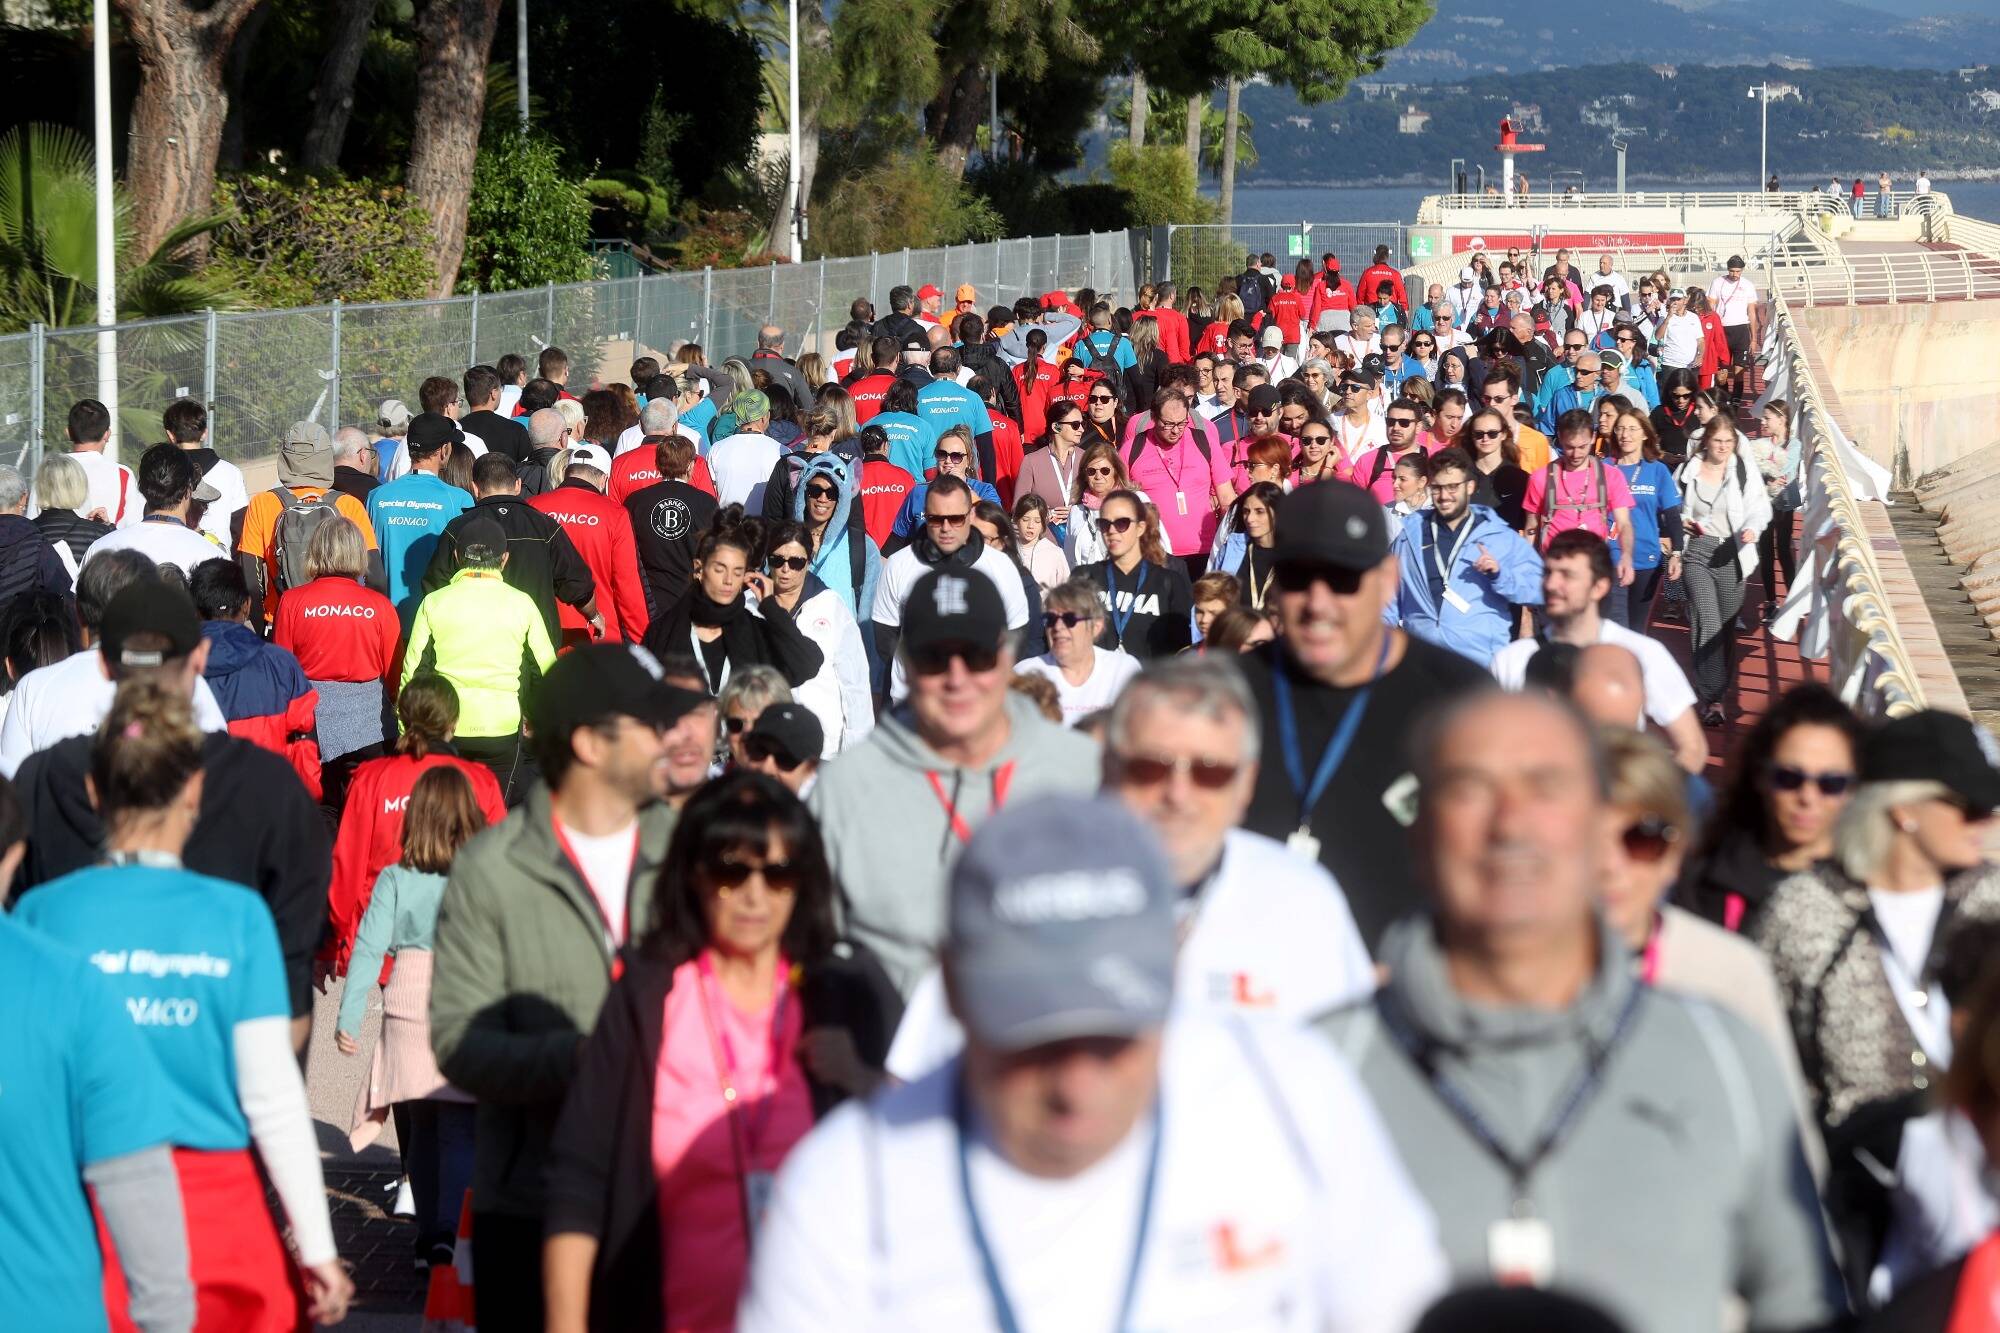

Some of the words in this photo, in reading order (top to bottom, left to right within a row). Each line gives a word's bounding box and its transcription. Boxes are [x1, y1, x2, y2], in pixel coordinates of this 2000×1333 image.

[1020, 373, 1050, 381] MACO
[854, 392, 888, 402] MONAC
[629, 470, 663, 481] MONA
[861, 483, 905, 496] MONACO
[378, 500, 406, 510] Special
[406, 500, 443, 511] Olympics
[658, 499, 686, 510] BARNES
[387, 516, 428, 527] MONACO
[546, 511, 599, 526] ONACO
[304, 604, 375, 619] MONACO
[126, 997, 198, 1026] NACO
